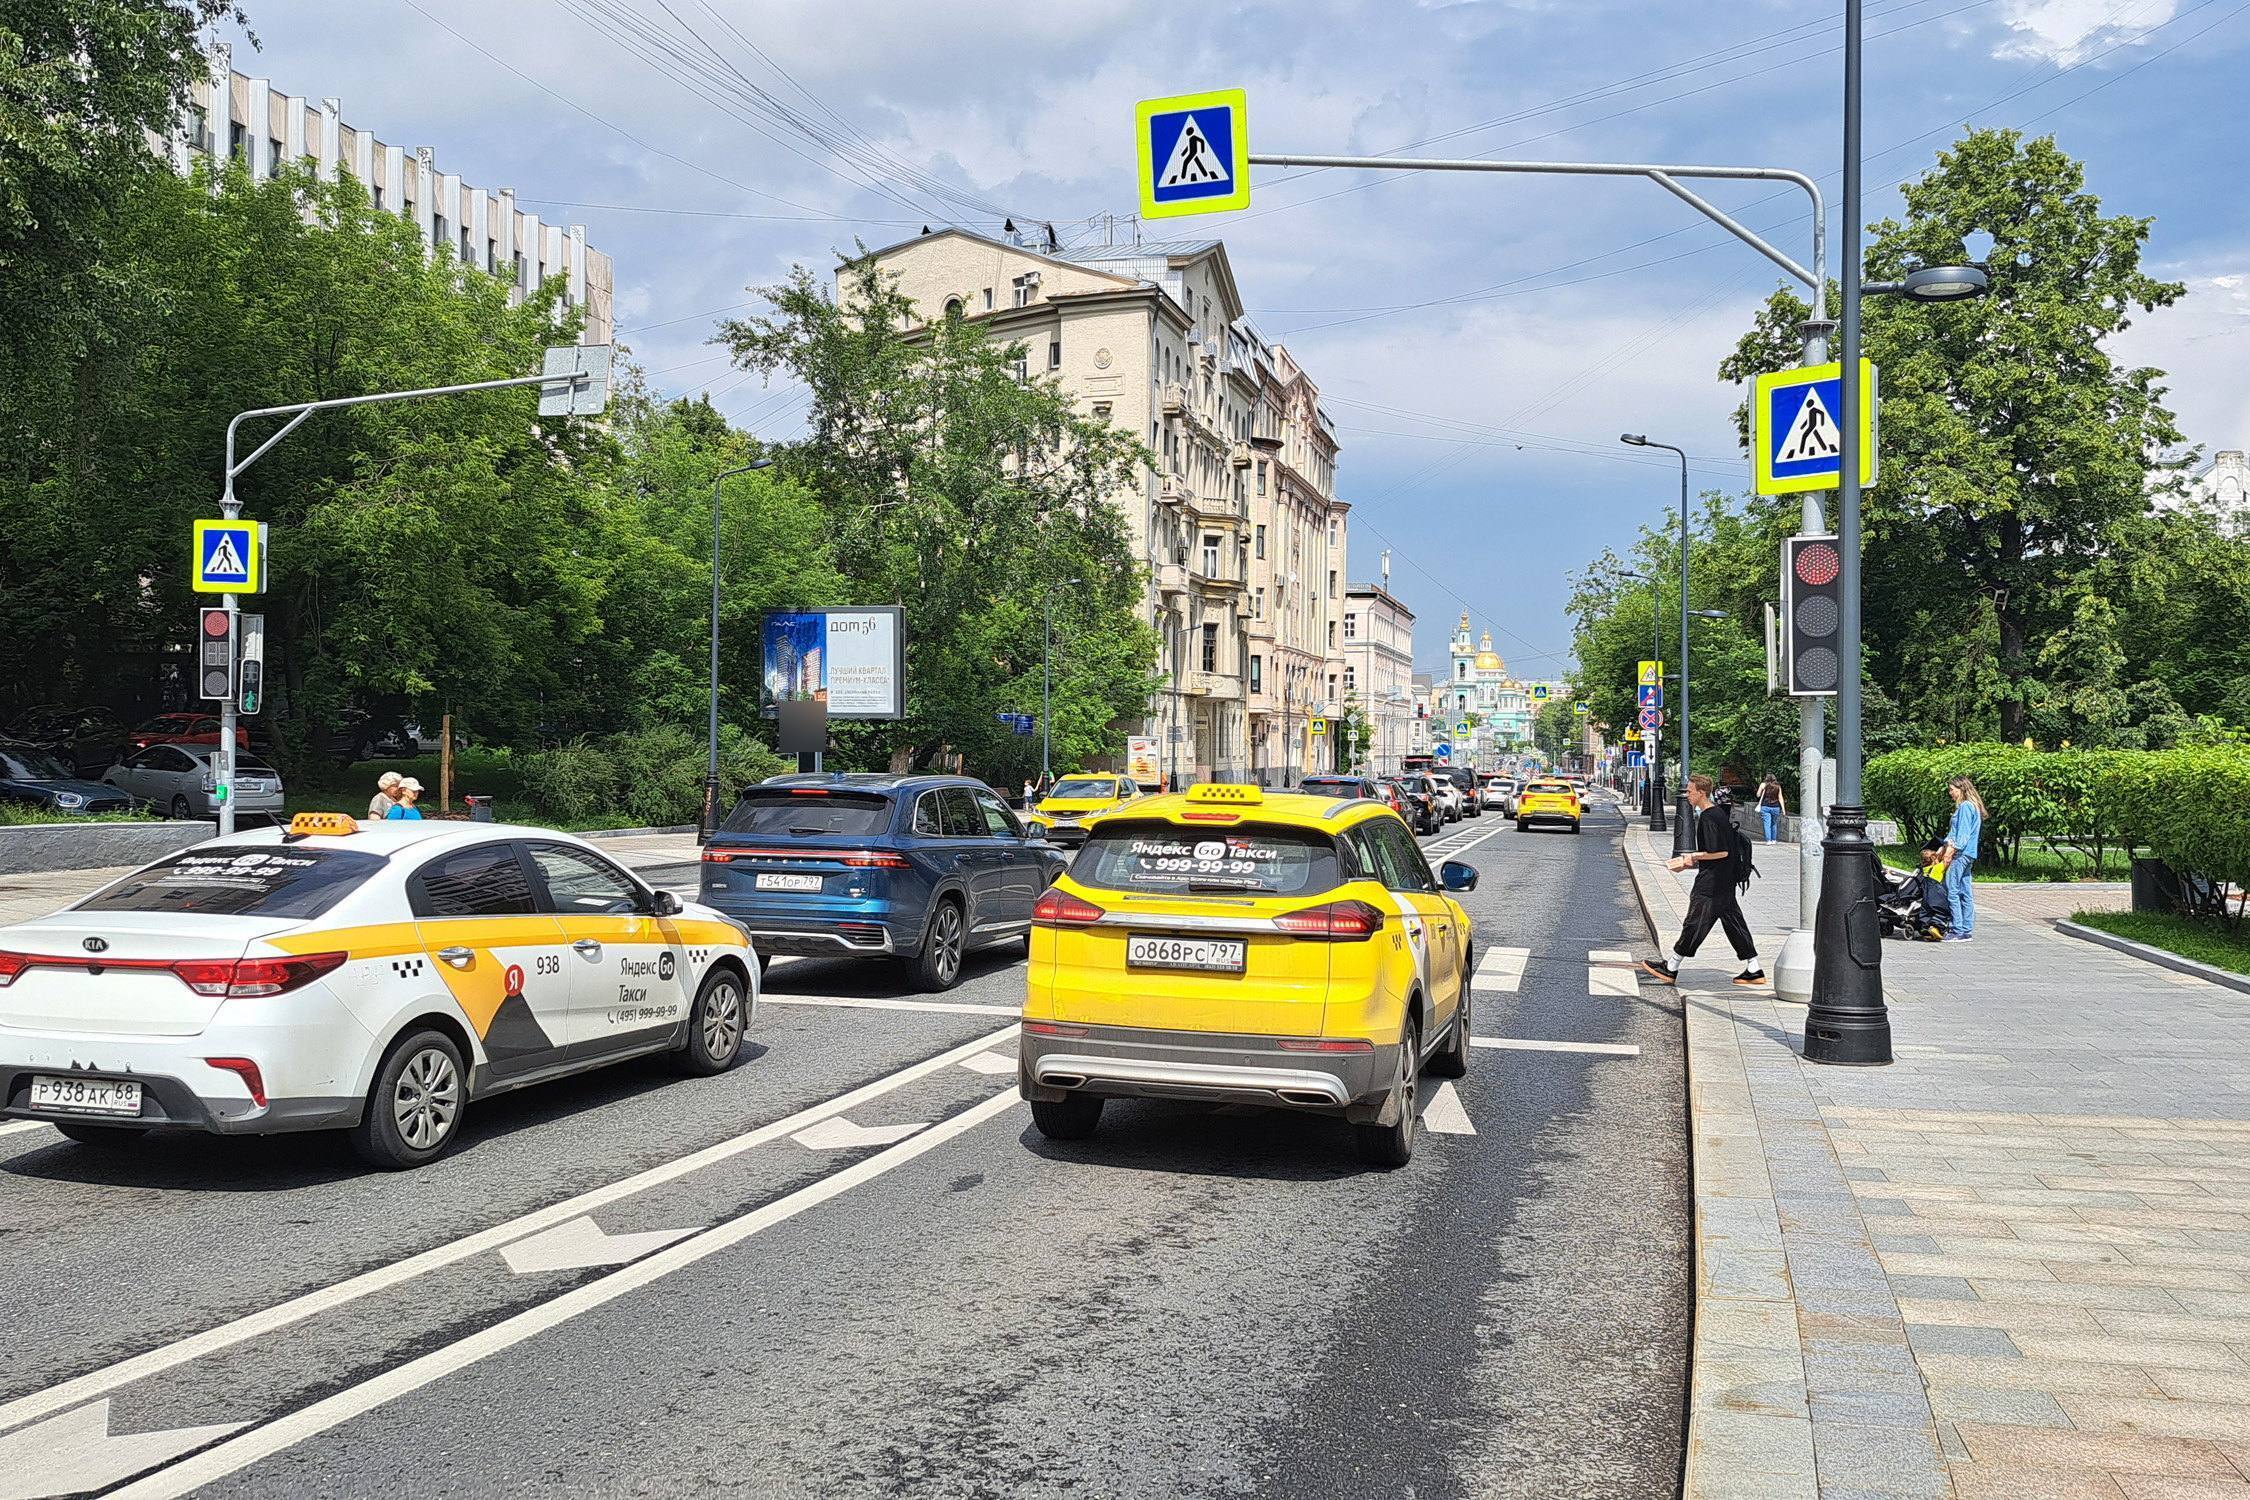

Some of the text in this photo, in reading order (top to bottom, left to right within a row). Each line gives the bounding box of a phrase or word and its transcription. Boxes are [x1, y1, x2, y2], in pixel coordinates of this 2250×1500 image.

[862, 616, 876, 636] 56
[1131, 842, 1278, 859] Яндекс Go Такси
[183, 867, 283, 876] 999-99-99
[1155, 858, 1256, 874] 999-99-99
[85, 940, 103, 950] KIA
[1210, 943, 1237, 959] 797
[536, 956, 560, 975] 938
[621, 954, 674, 977] Яндекс Go
[618, 984, 647, 1002] Такси
[616, 1004, 677, 1023] (495) 999-99-99
[115, 1083, 133, 1100] 68
